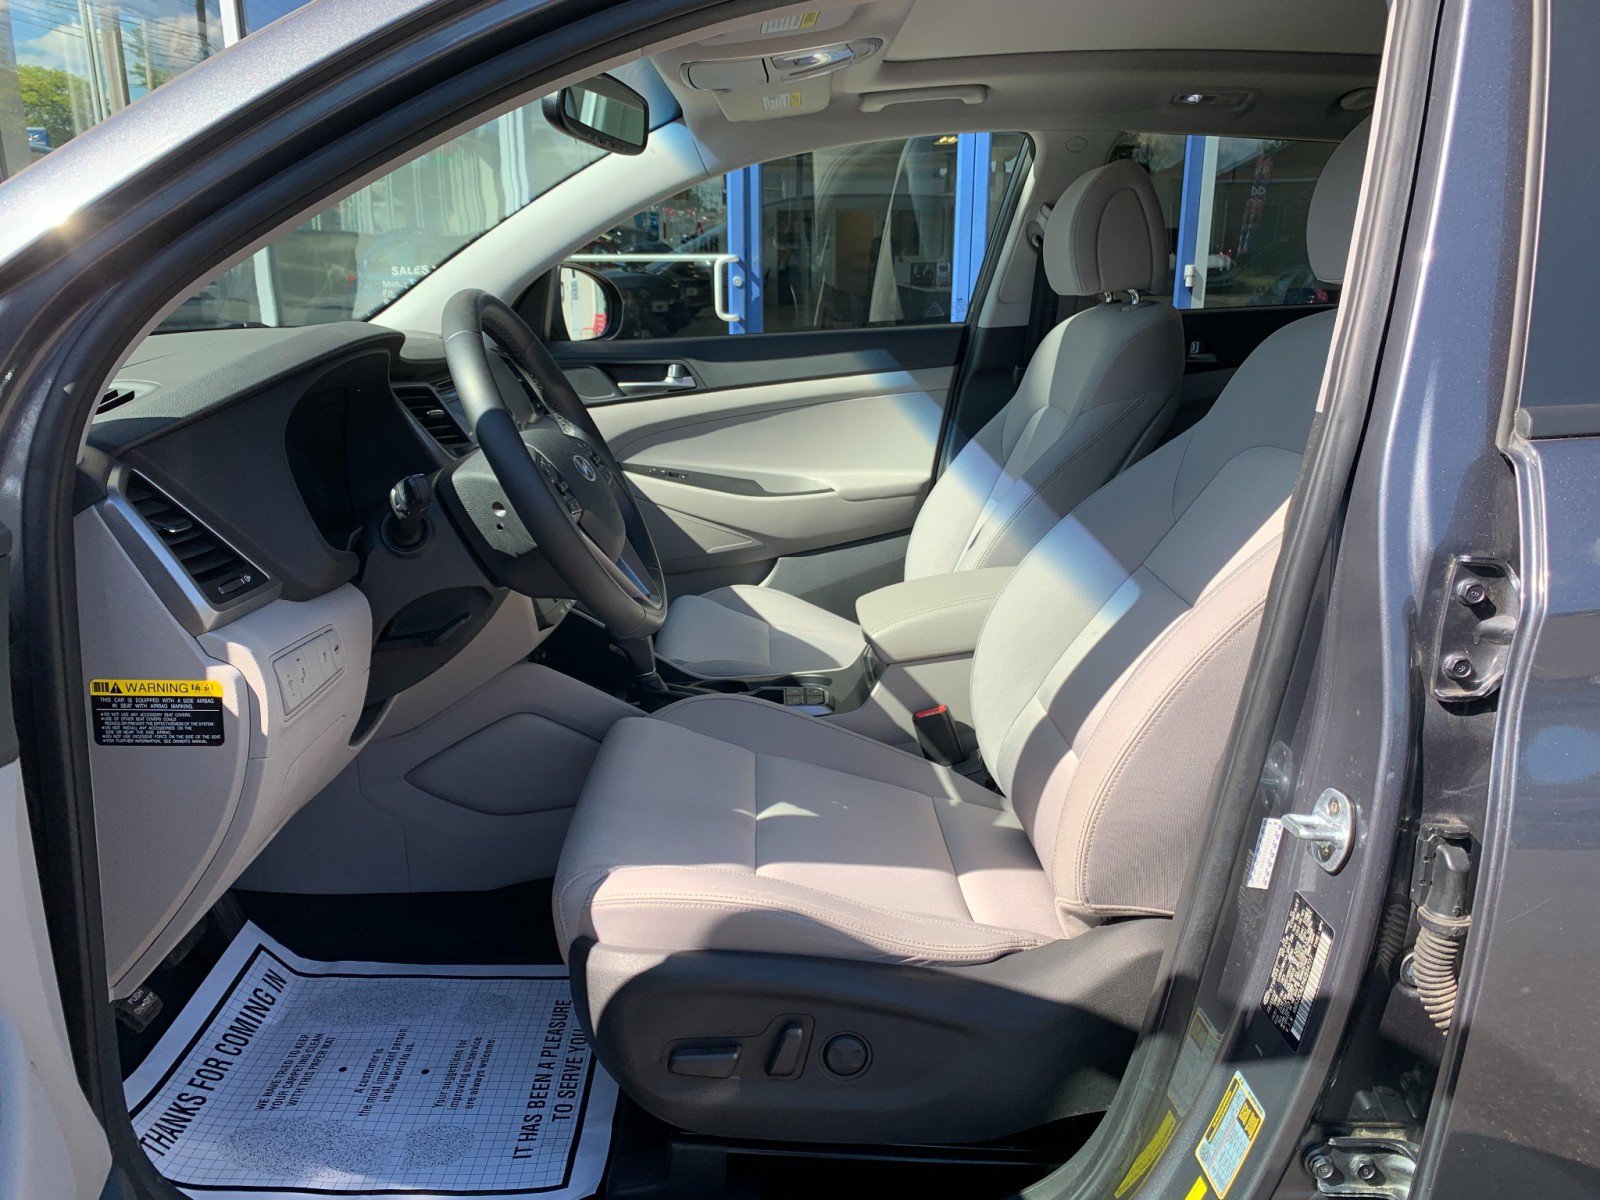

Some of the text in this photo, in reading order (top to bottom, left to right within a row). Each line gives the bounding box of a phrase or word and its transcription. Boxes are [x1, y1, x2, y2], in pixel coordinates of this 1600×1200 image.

[391, 265, 430, 276] SALES
[125, 682, 189, 693] WARNING
[127, 990, 144, 1004] PUSH
[140, 968, 288, 1156] THANKS FOR COMING IN
[254, 1034, 309, 1110] WE HAVE TRIED TO KEEP
[269, 1033, 324, 1110] YOUR CARPETING CLEAN
[286, 1036, 336, 1106] WITH THIS PAPER MAT
[358, 1051, 380, 1087] customer
[358, 1028, 408, 1116] the most important person
[384, 1082, 398, 1094] the
[393, 1061, 407, 1081] world
[405, 1042, 416, 1052] us.
[432, 1040, 468, 1108] Your suggestions for
[447, 1036, 482, 1110] improving our service
[465, 1037, 496, 1110] are always welcome.
[512, 1000, 572, 1160] IT HAS BEEN A PLEASURE
[552, 1028, 588, 1123] TO SERVE YOU
